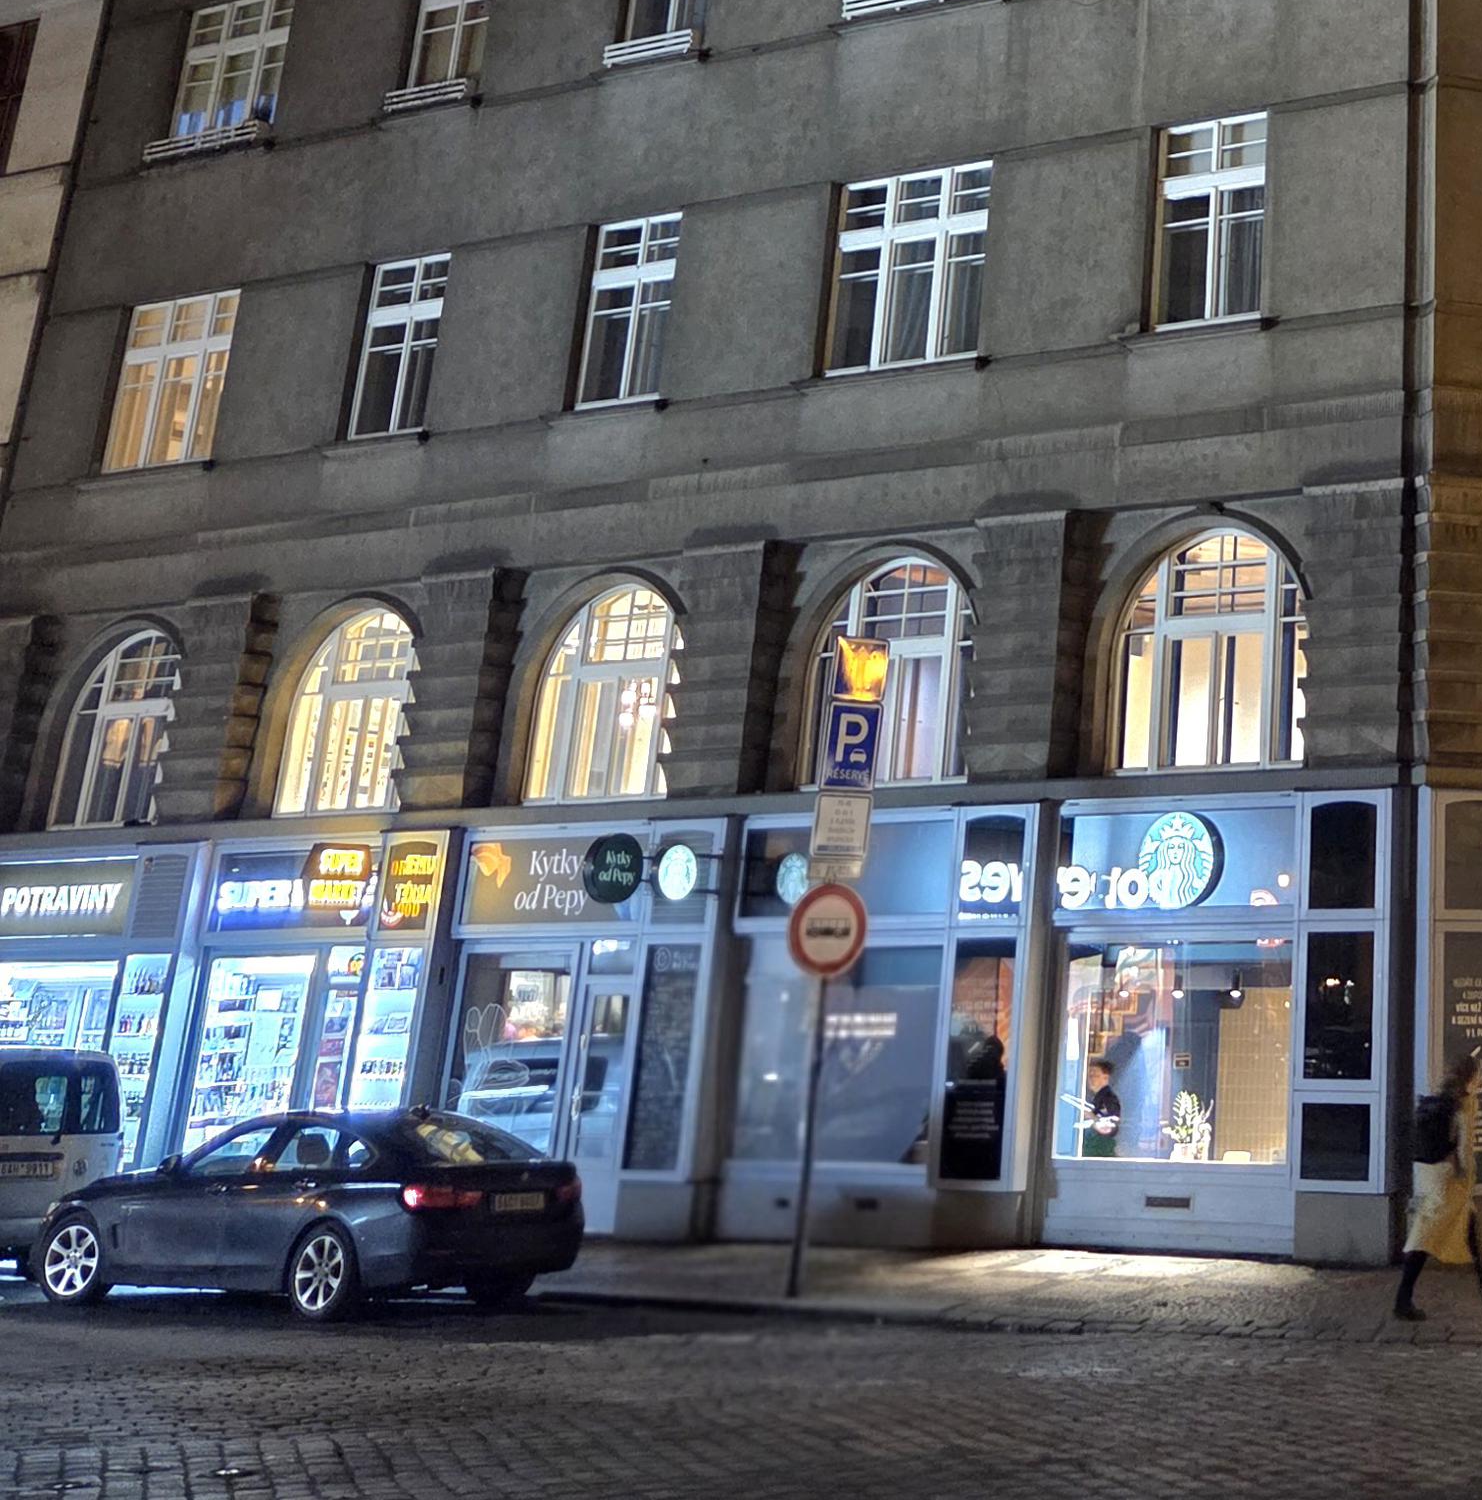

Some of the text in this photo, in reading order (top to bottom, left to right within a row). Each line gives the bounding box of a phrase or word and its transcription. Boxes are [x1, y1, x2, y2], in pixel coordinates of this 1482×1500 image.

[834, 712, 869, 763] P
[319, 849, 365, 876] SUPER
[529, 848, 584, 881] Kytky
[1, 882, 123, 916] POTRAVINY
[514, 884, 588, 916] od Pepy
